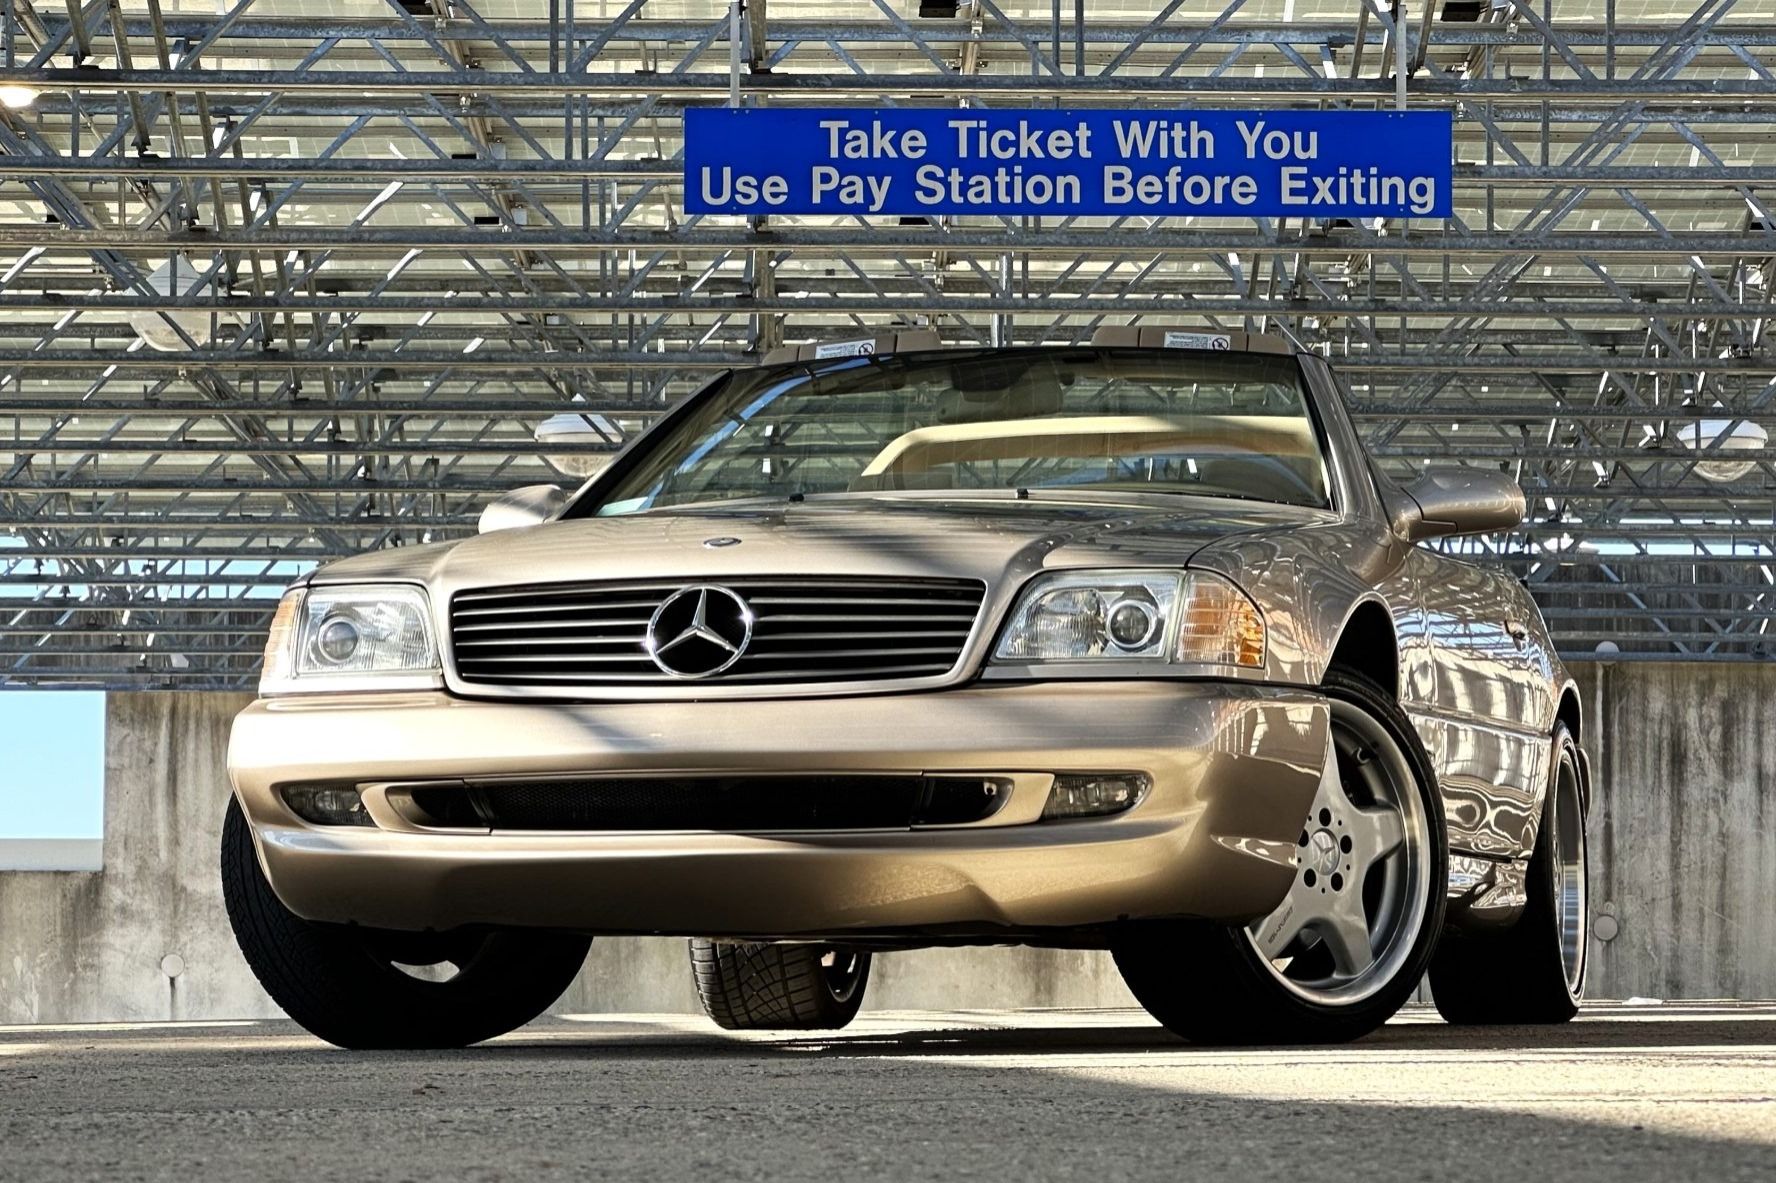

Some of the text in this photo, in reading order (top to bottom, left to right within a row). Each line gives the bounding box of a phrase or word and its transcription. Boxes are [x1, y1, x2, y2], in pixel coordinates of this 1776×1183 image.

[819, 120, 1319, 160] Take Ticket With You
[701, 165, 1436, 214] Use Pay Station Before Exiting
